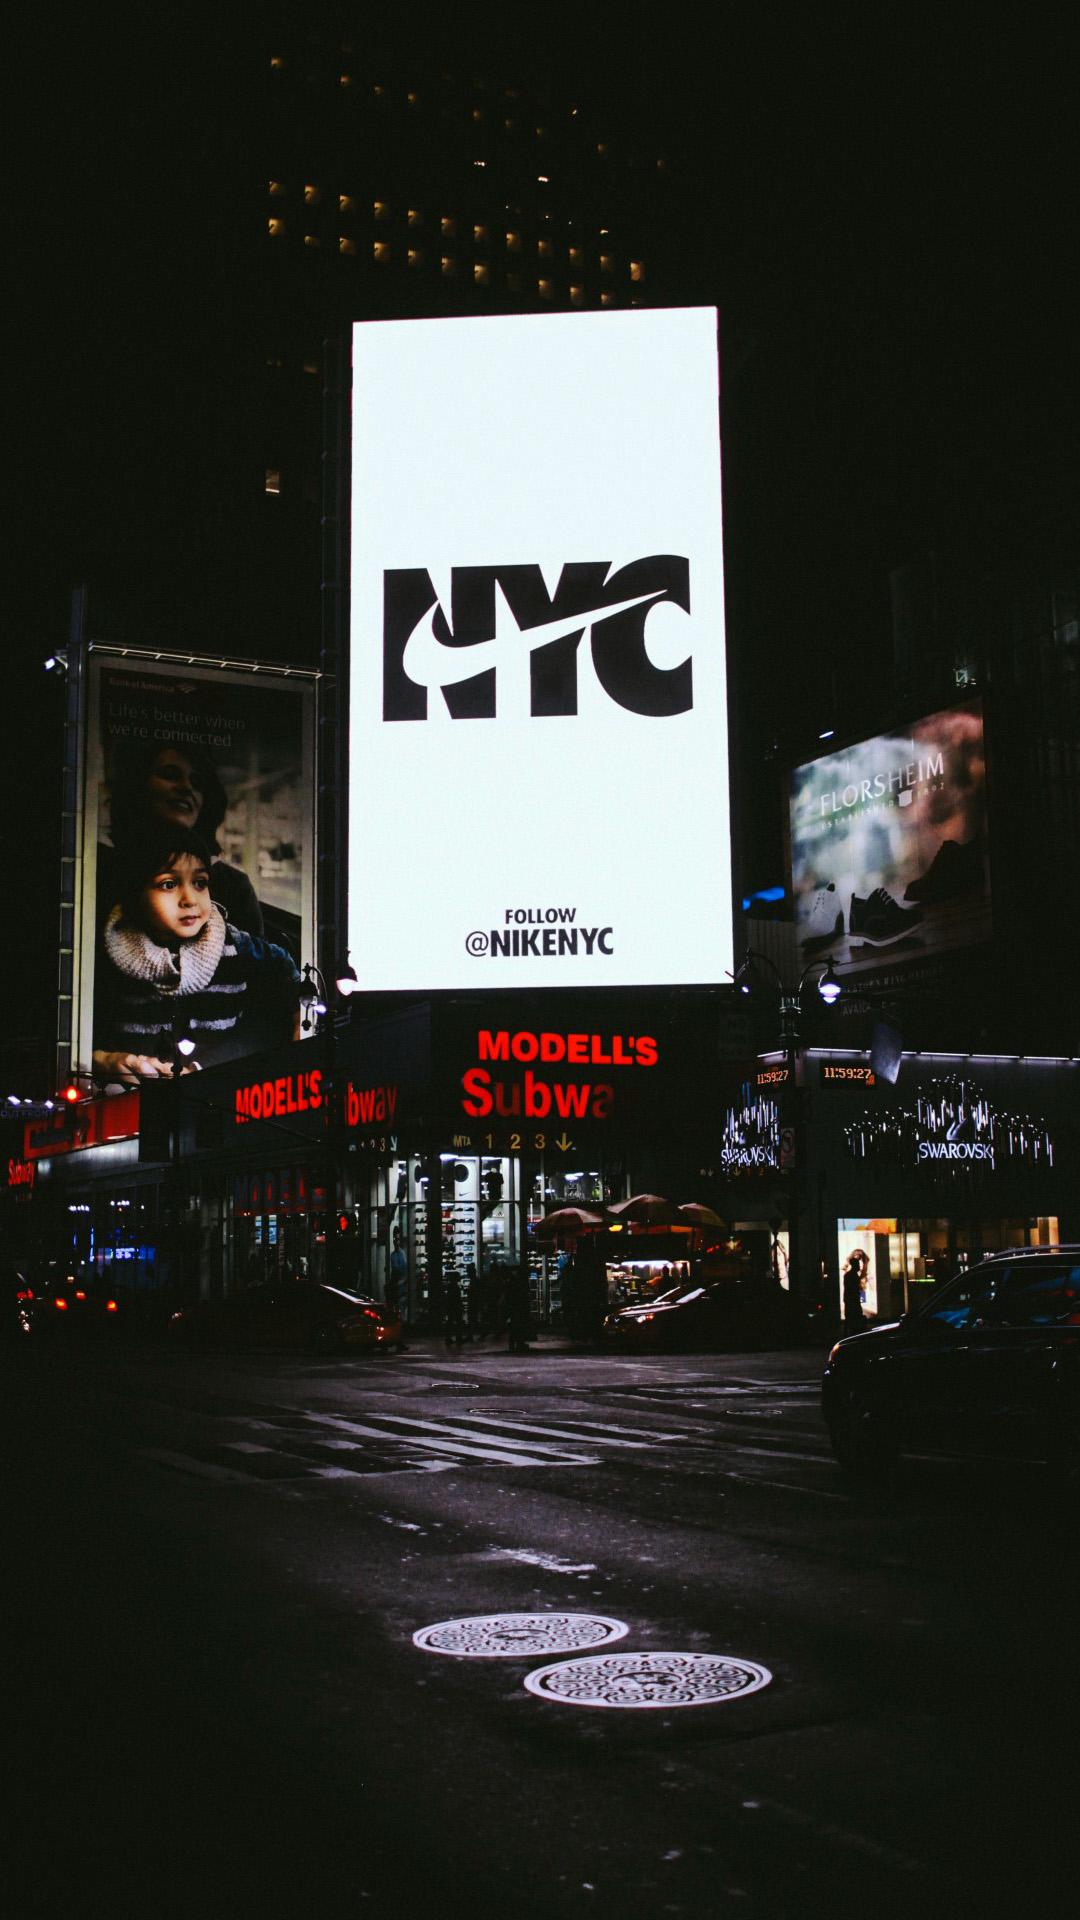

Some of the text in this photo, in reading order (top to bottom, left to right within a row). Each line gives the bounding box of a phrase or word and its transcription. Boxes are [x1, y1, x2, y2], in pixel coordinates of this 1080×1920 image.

[383, 554, 694, 722] NYC
[108, 676, 175, 693] Bank of America
[108, 702, 245, 731] Life's better when
[108, 722, 231, 748] we're connected
[820, 752, 944, 816] FLORSHEIM
[821, 782, 946, 830] ESTABLISHED 1892
[505, 907, 577, 924] FOLLOW
[465, 926, 614, 957] @NIKENYC
[478, 1030, 659, 1067] MODELL'S
[756, 1069, 789, 1085] 11:59:27
[824, 1066, 872, 1079] 11:59:27
[235, 1069, 323, 1124] MODELL'S
[324, 1080, 397, 1131] bway
[461, 1067, 615, 1119] Subwa
[453, 1132, 546, 1150] MTA 1 2 3
